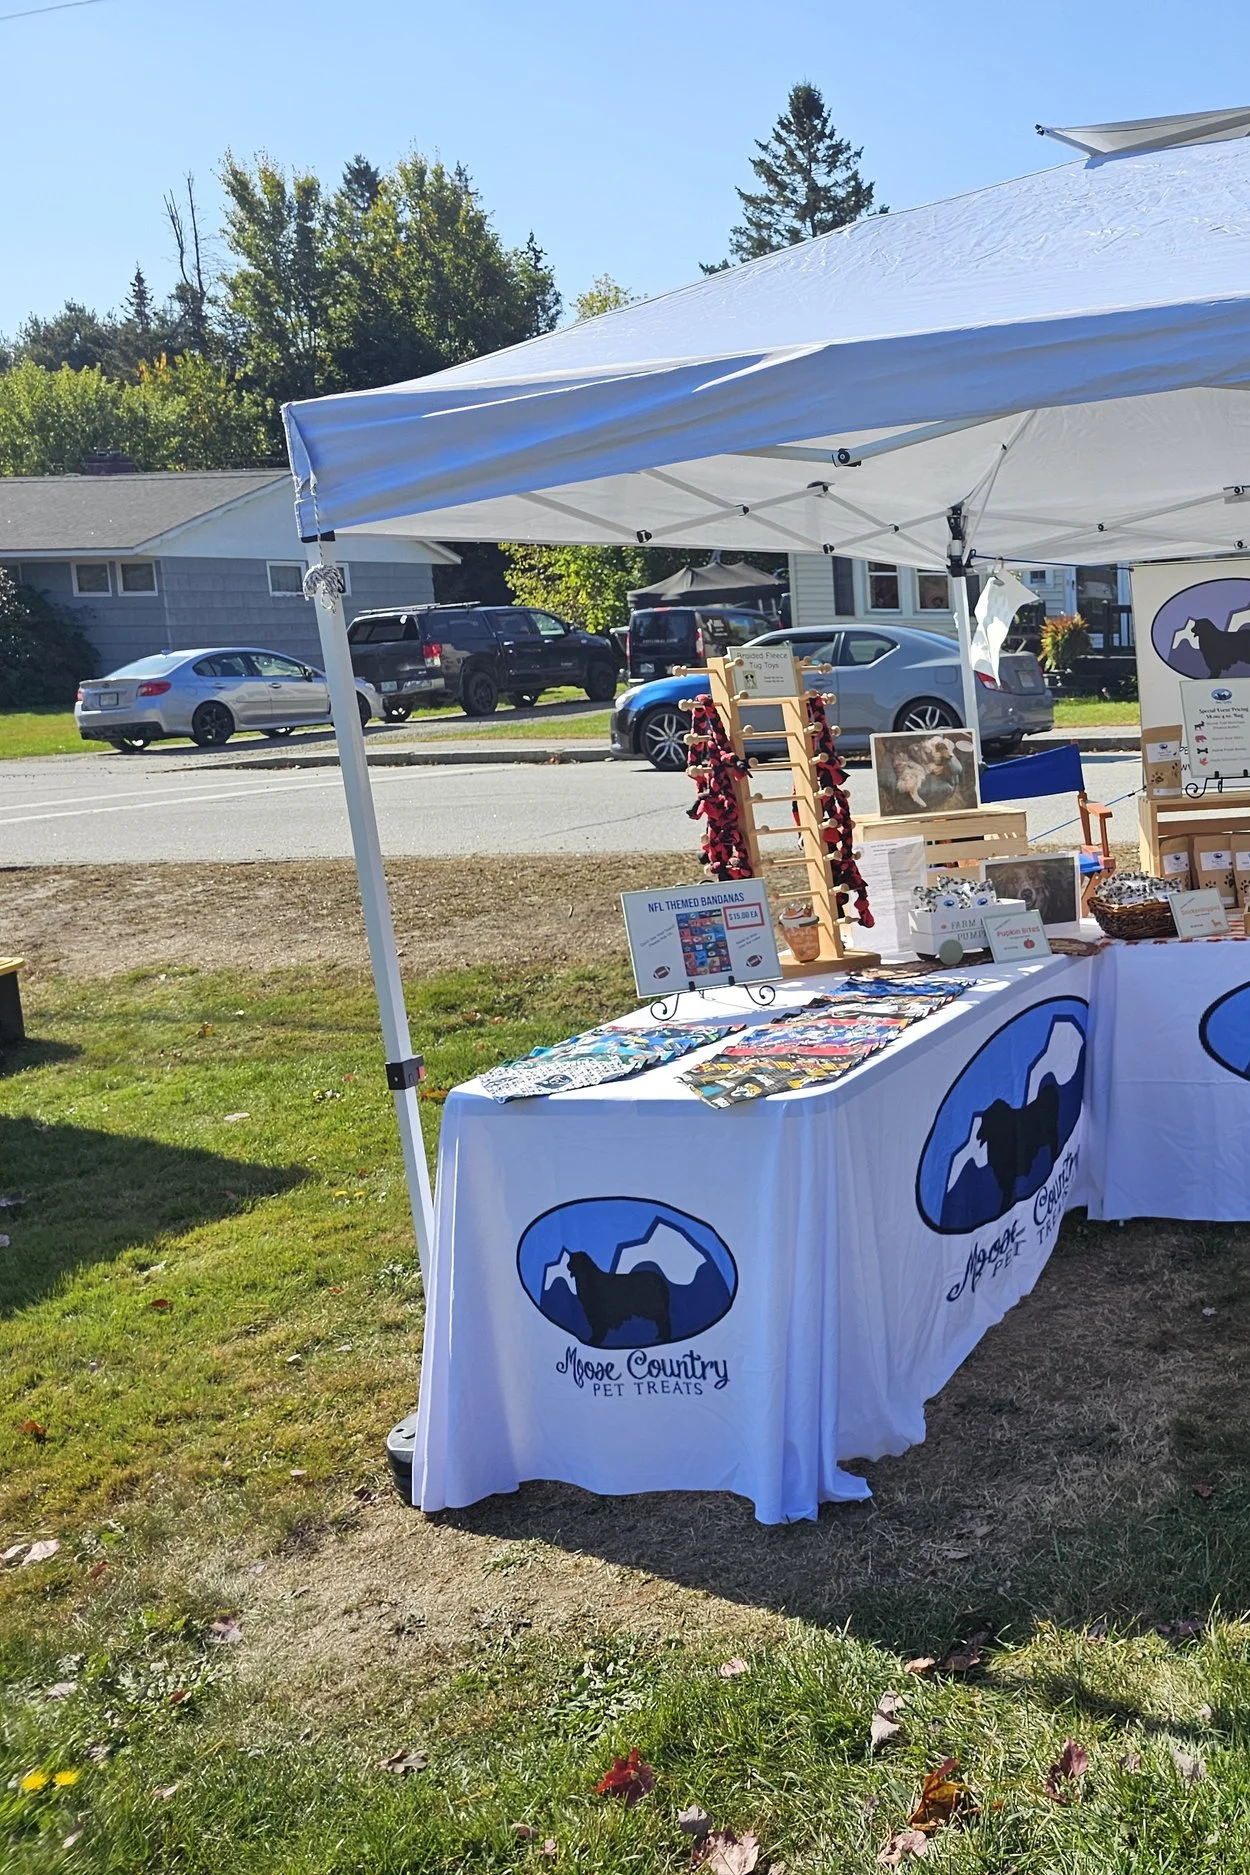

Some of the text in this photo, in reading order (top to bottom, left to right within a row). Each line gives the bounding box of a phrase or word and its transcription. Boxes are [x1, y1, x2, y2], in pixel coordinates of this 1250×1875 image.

[765, 651, 788, 659] Fleece
[764, 661, 780, 669] Toys
[648, 892, 745, 913] NFL THEMED BANDANAS
[728, 910, 758, 921] $15.00 EA
[951, 920, 977, 930] FARM
[946, 1219, 1026, 1303] Moose
[991, 1240, 1026, 1279] PET
[556, 1346, 731, 1390] Moose Country
[593, 1380, 704, 1398] PET TREATS
